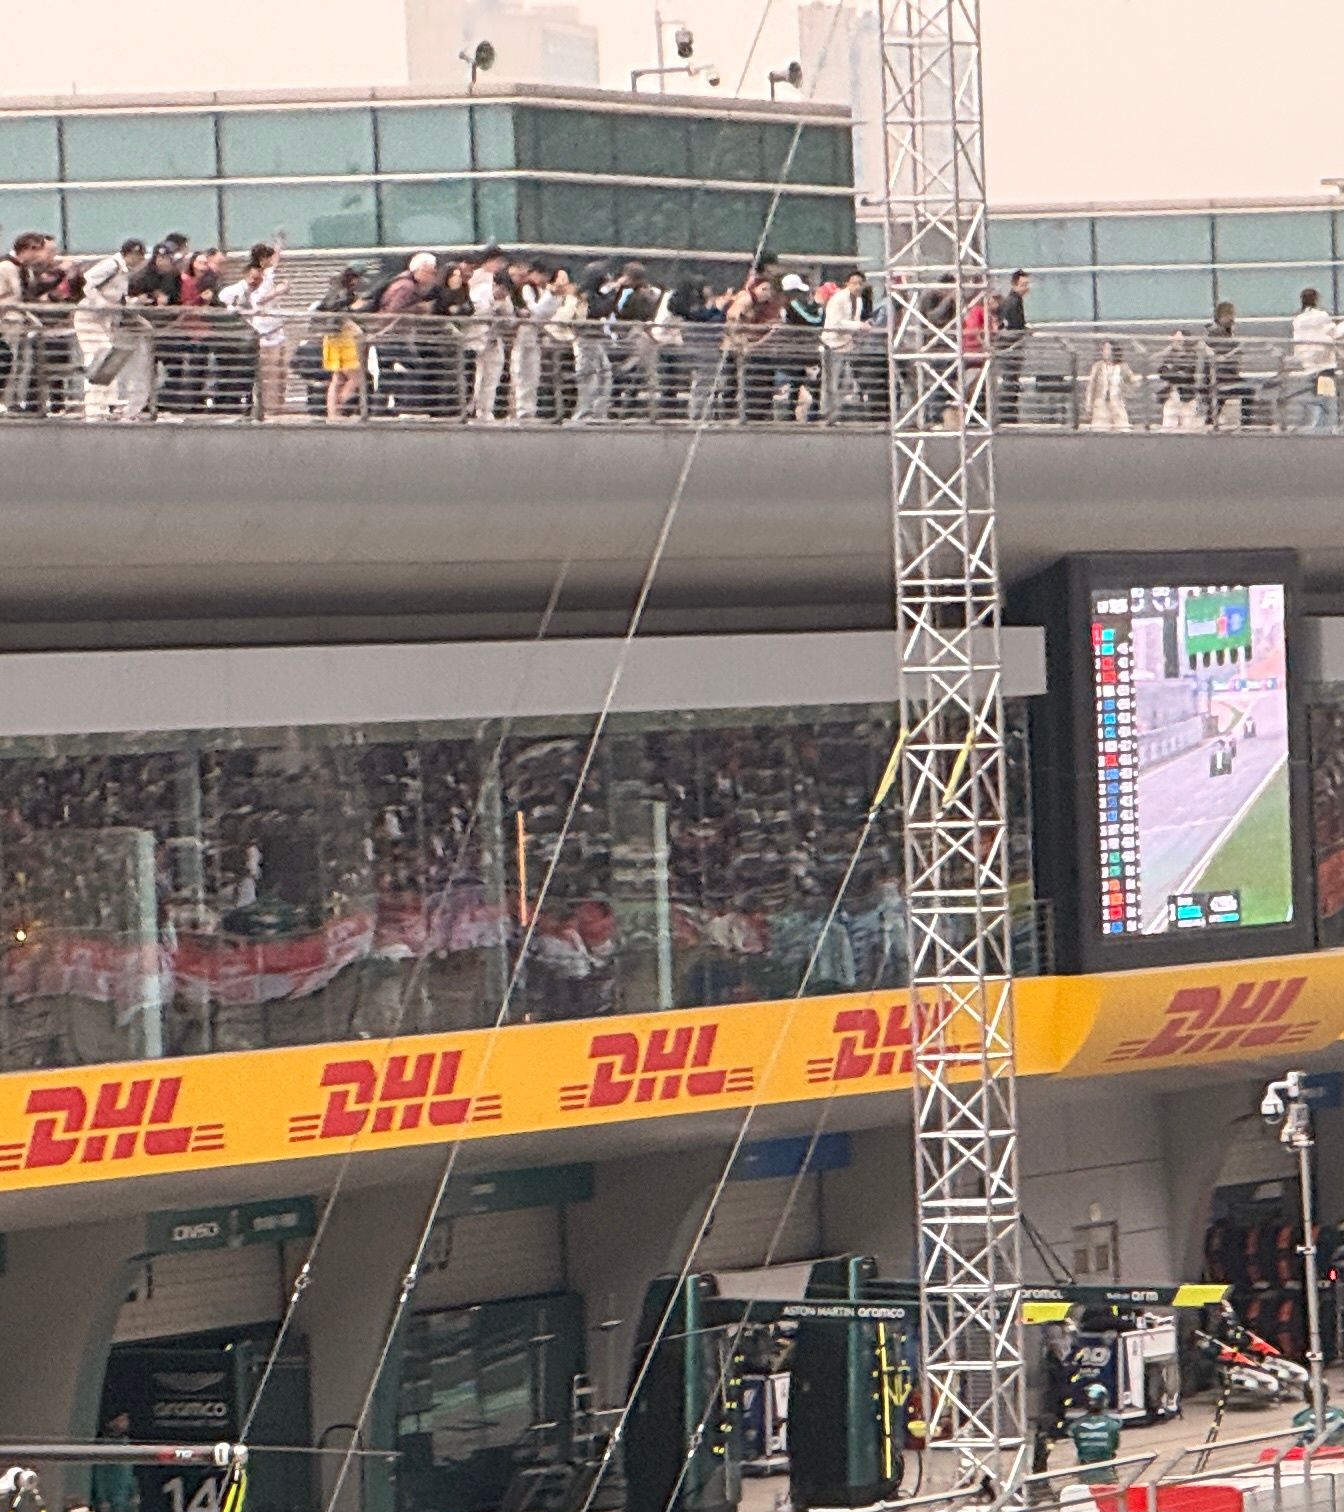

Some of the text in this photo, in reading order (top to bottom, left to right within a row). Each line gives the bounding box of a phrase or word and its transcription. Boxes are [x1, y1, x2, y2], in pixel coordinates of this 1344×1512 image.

[1134, 976, 1308, 1059] DHL
[320, 1050, 473, 1140] DHL
[588, 1024, 727, 1108] DHL
[25, 1077, 193, 1170] DHL
